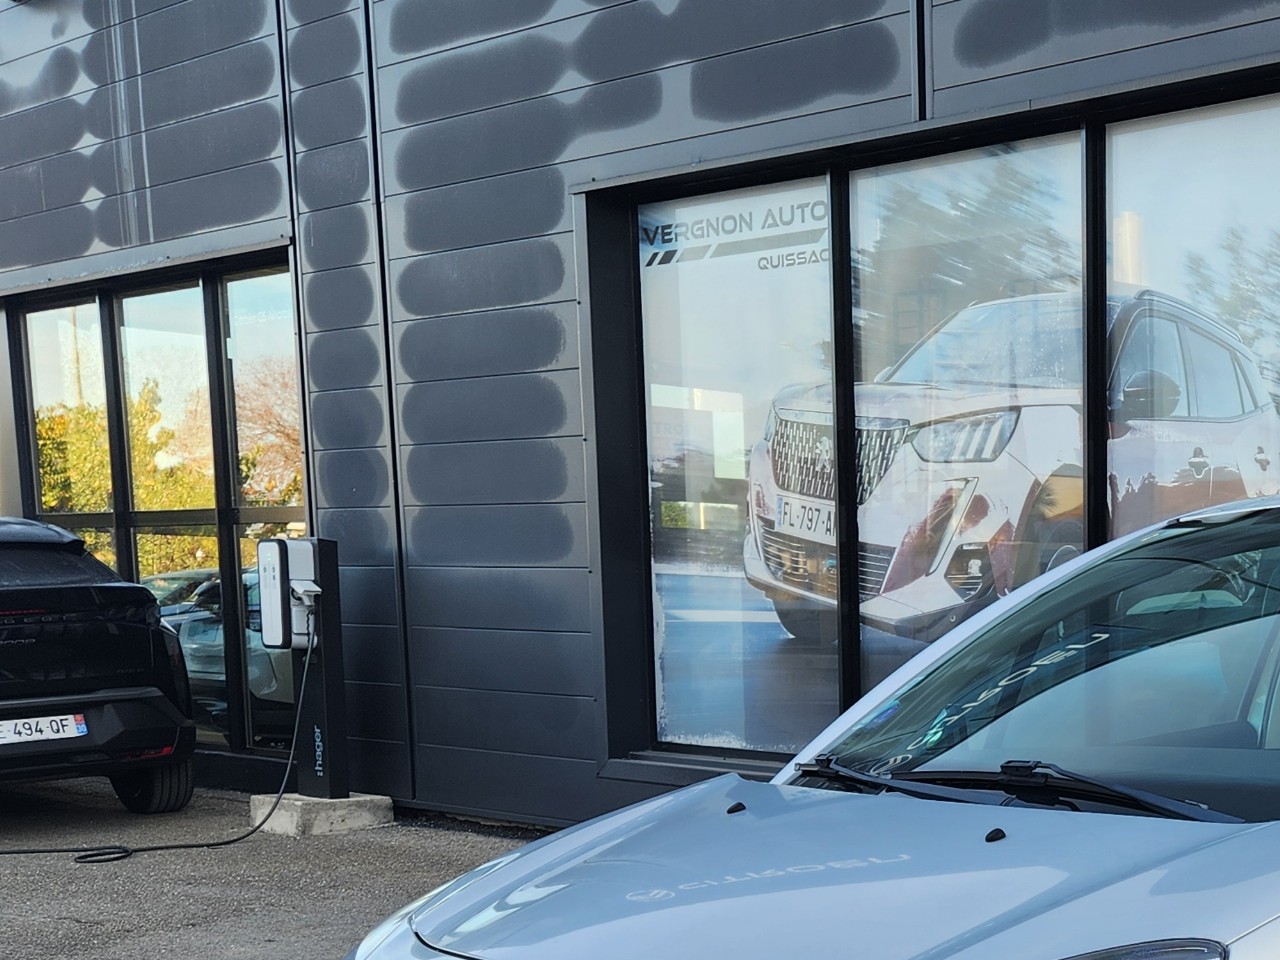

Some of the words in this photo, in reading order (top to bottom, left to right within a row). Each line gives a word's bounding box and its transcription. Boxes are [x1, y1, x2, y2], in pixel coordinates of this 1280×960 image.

[642, 211, 753, 246] VERGNON
[760, 200, 829, 230] AUTO
[758, 248, 830, 270] QUISSAC
